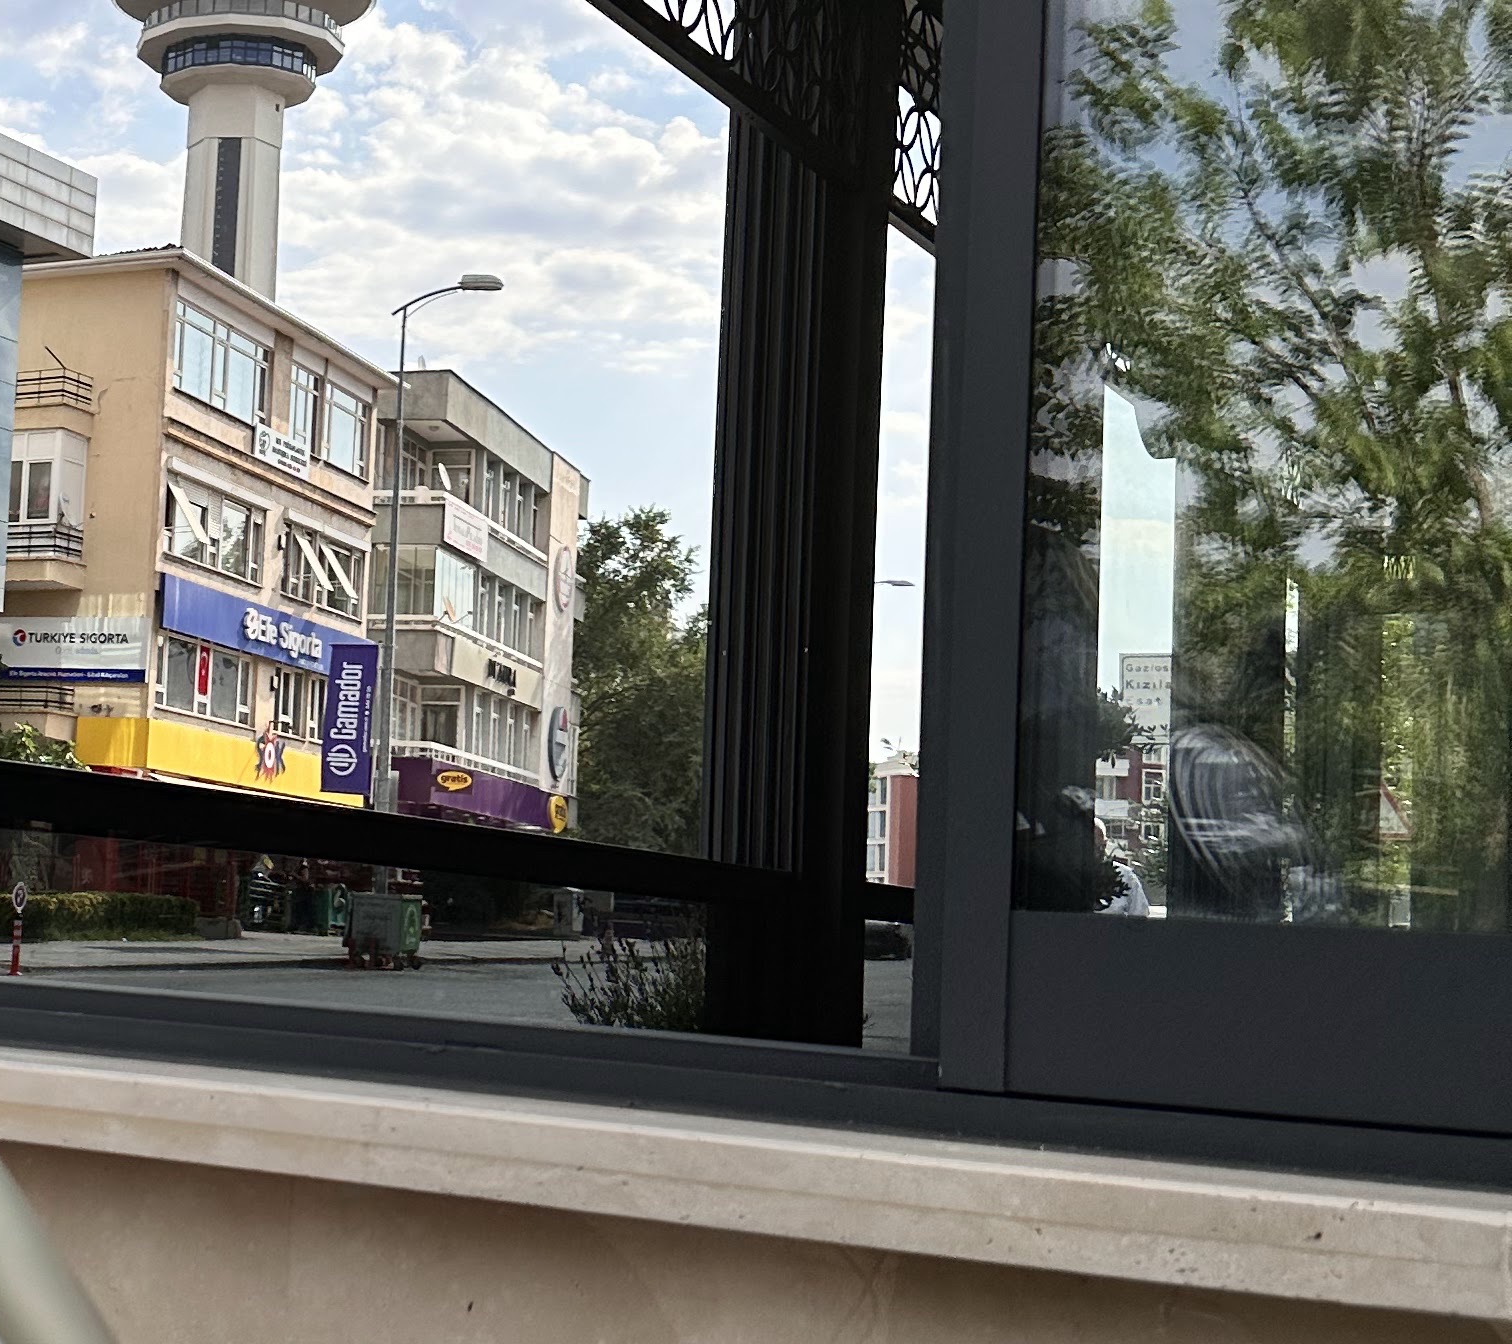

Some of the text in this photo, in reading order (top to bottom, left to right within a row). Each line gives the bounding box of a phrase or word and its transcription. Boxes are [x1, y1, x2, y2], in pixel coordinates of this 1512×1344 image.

[279, 621, 323, 659] Sigorta
[329, 661, 364, 740] Gamador
[440, 772, 469, 785] gratis
